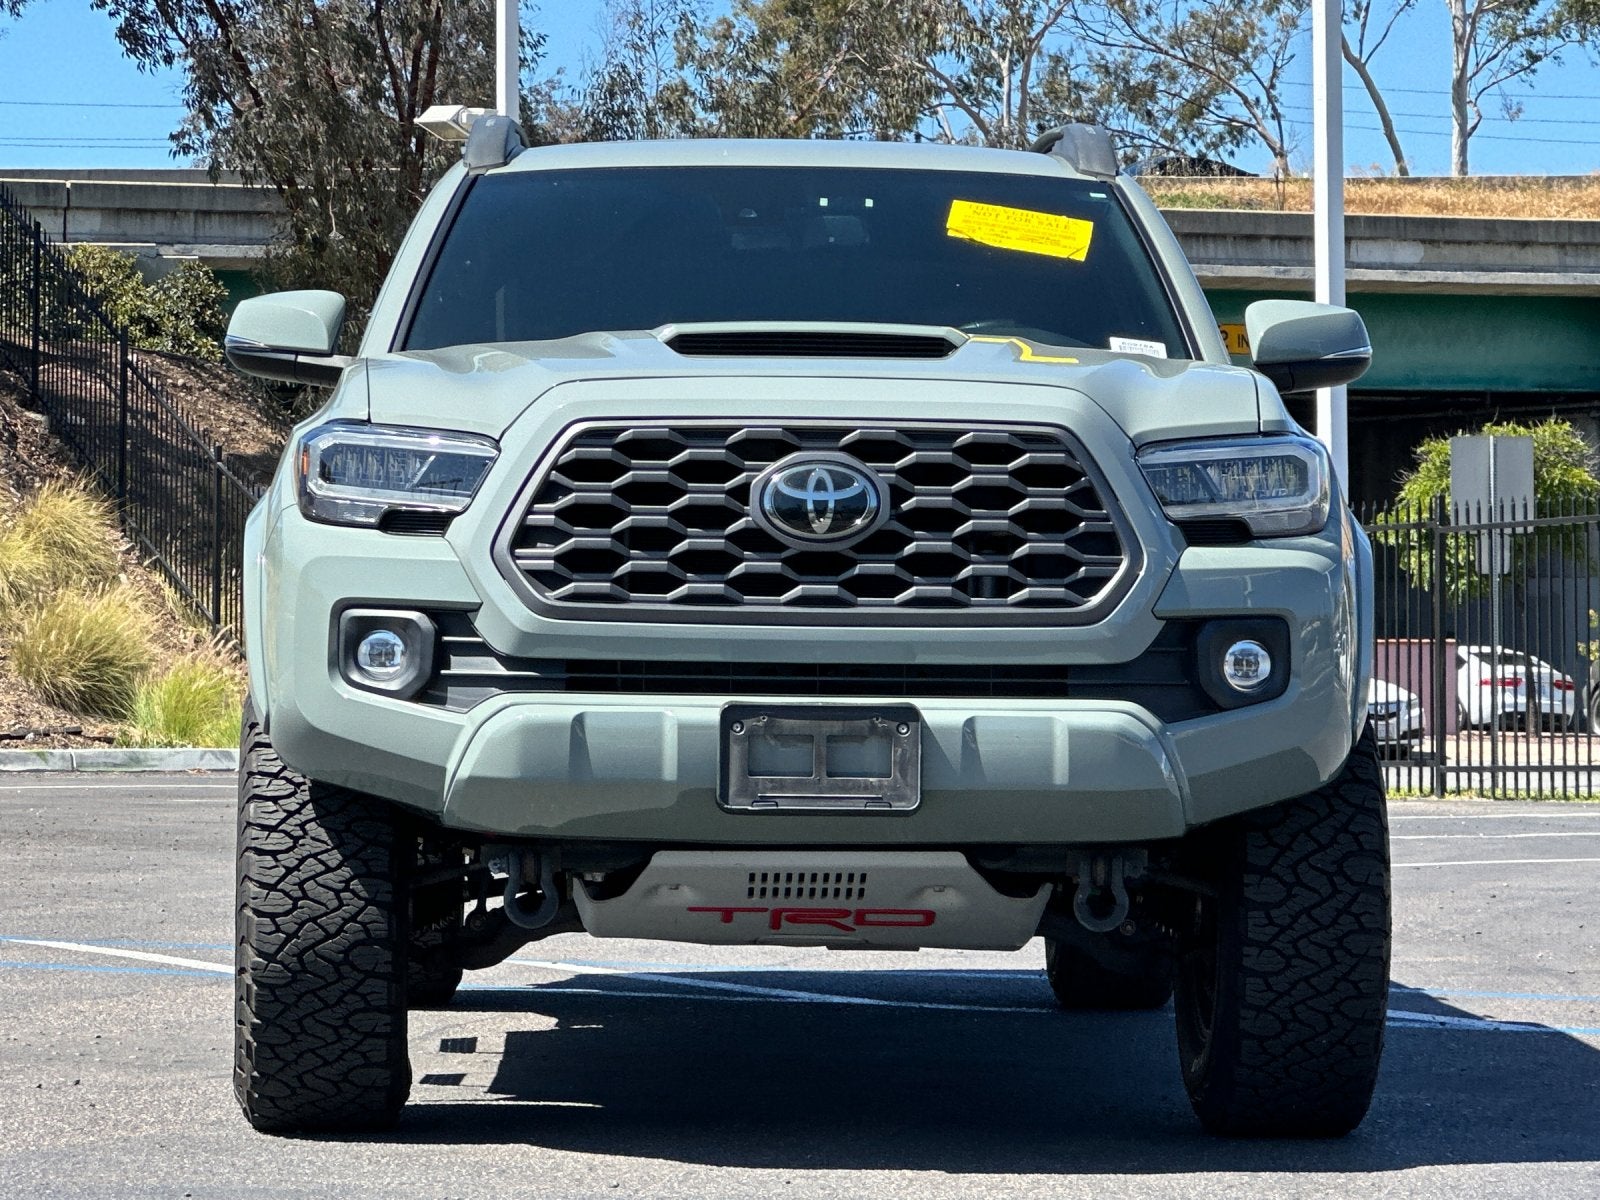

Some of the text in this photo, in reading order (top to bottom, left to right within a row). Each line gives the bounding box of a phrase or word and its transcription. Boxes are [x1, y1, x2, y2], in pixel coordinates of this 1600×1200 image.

[973, 210, 1000, 219] NOT
[1007, 215, 1031, 224] FOR
[1038, 221, 1070, 230] SALE
[687, 907, 935, 931] TRD
